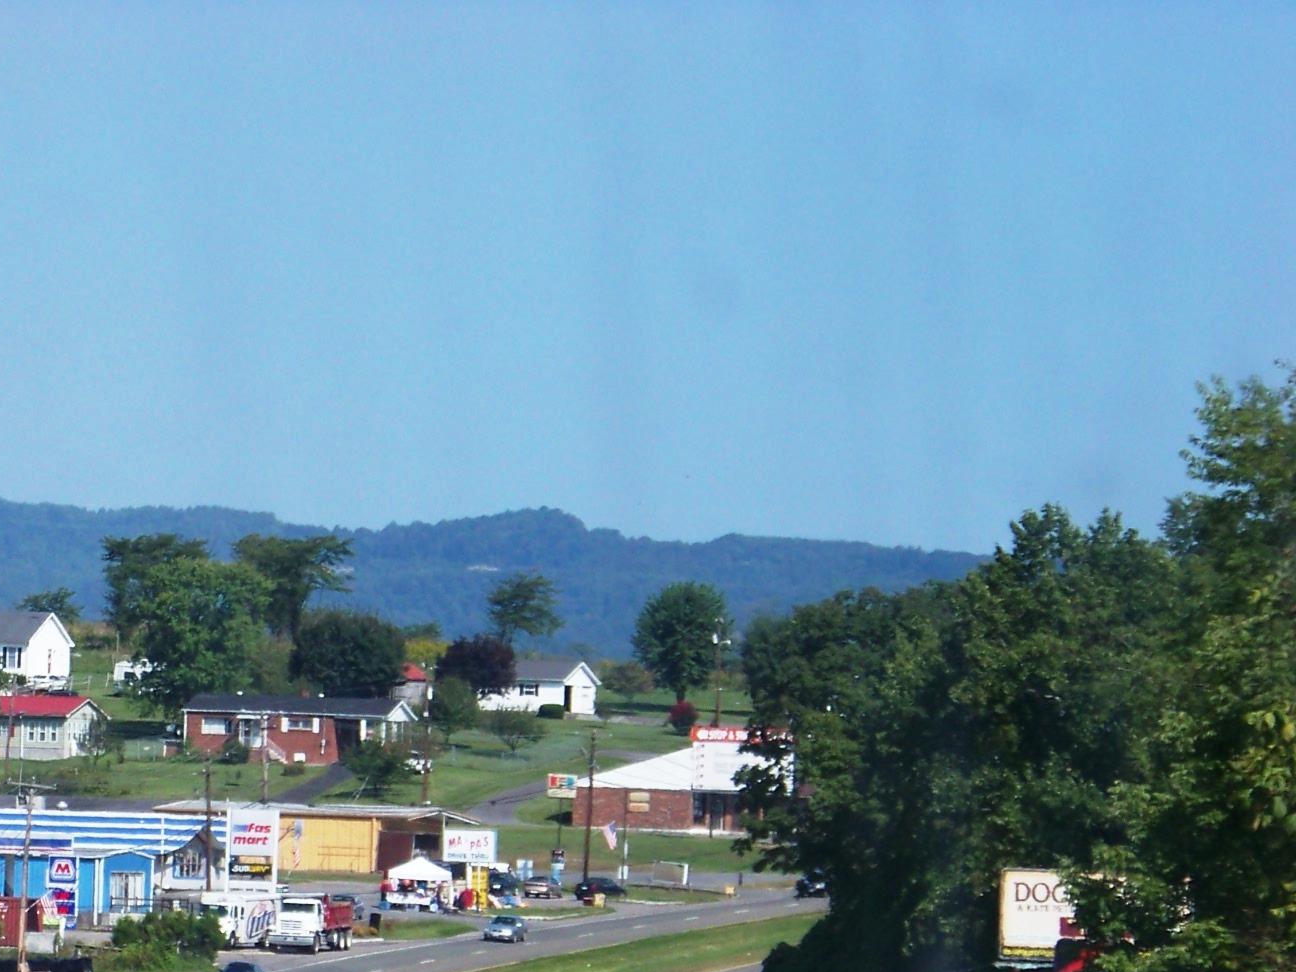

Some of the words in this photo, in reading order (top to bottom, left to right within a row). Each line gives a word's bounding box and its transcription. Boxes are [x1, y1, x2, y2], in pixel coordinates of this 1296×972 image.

[247, 823, 271, 833] fas
[233, 836, 269, 845] mart
[56, 864, 70, 873] M
